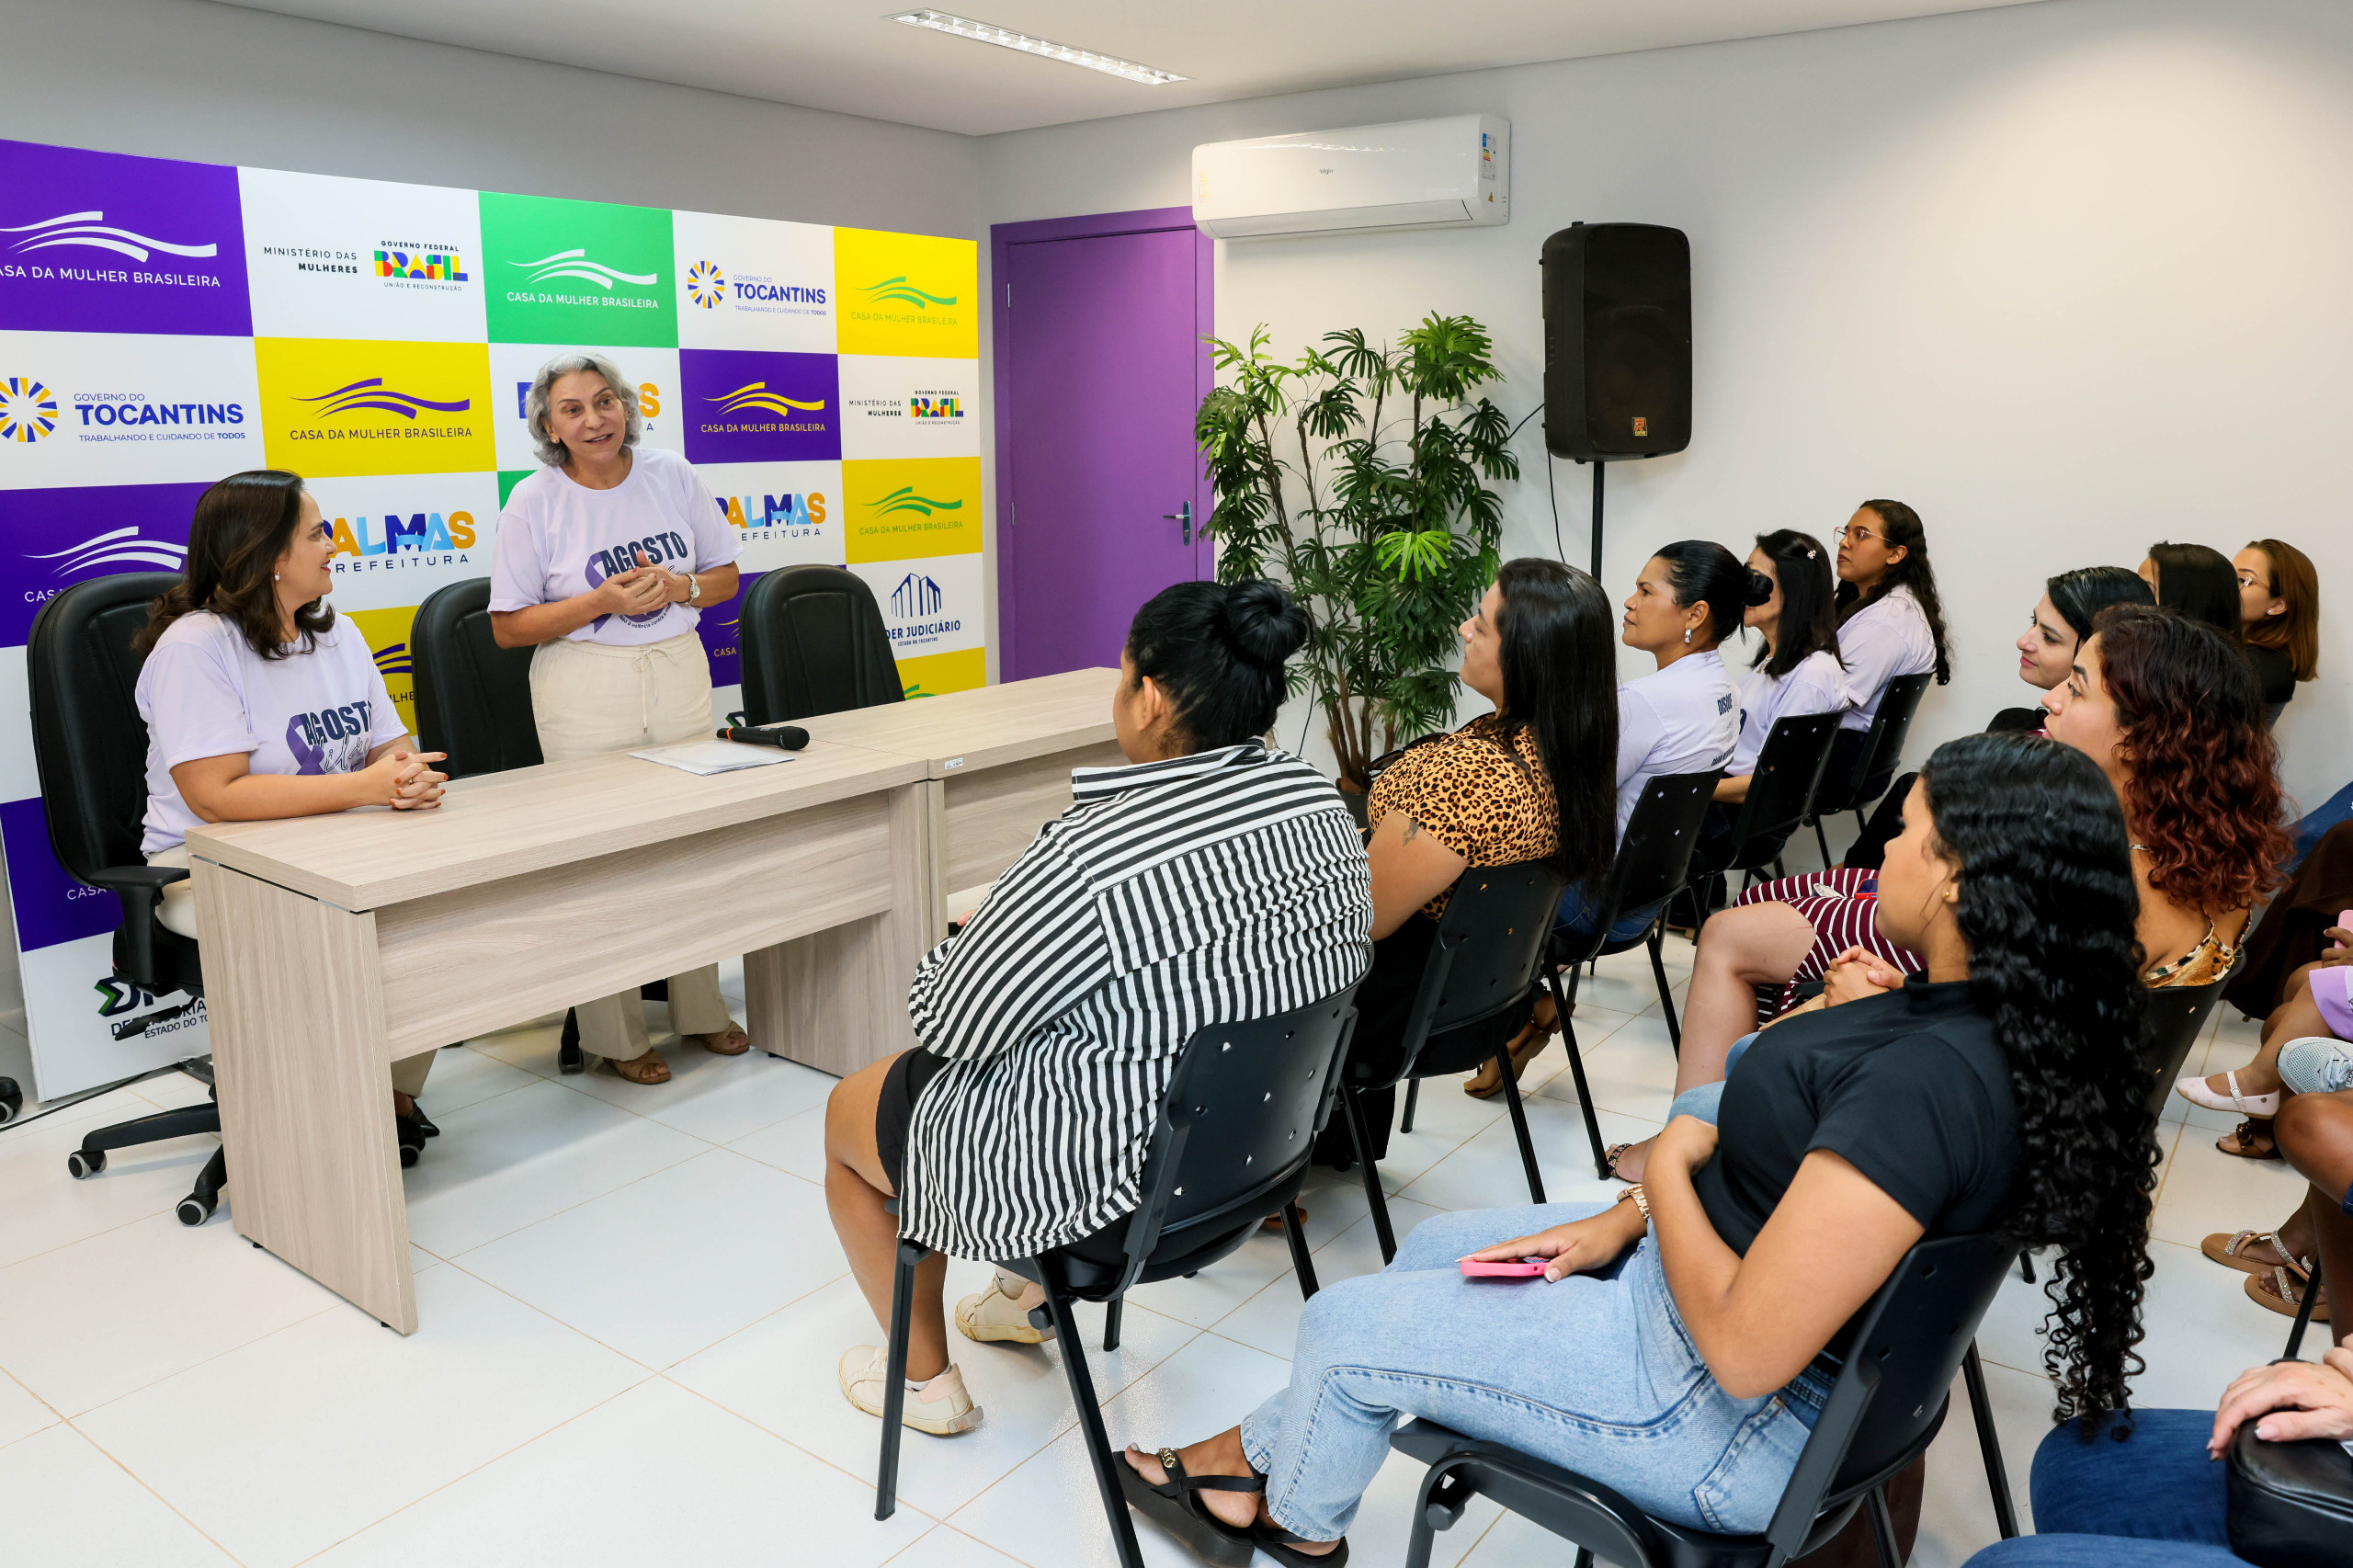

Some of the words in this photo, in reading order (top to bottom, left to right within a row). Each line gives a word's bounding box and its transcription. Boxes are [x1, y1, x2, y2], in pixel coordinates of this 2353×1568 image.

[264, 246, 331, 258] MINISTÉRIO
[336, 252, 357, 260] DAS
[381, 241, 421, 249] GOVERNO
[425, 243, 460, 252] FEDERAL
[298, 263, 358, 273] MULHERES
[374, 250, 468, 281] BRASIL
[0, 265, 26, 278] SA
[31, 267, 54, 278] DA
[60, 268, 128, 282] MULHER
[133, 272, 221, 287] BRASILEIRA
[733, 274, 762, 282] GOVERNO
[412, 283, 462, 291] RECONSTRUÇÃO
[733, 283, 825, 304] TOCANTINS
[506, 291, 536, 302] CASA
[539, 293, 553, 303] DA
[556, 294, 598, 305] MULHER
[602, 296, 658, 309] BRASILEIRA
[851, 312, 871, 321] CASA
[873, 312, 882, 321] DA
[885, 314, 915, 323] MULHER
[918, 316, 958, 325] BRASILEIRA
[75, 403, 244, 426] TOCANTINS
[911, 398, 963, 417] BRASIL
[290, 430, 324, 440] CASA
[328, 429, 345, 439] DA
[349, 428, 401, 438] MULHER
[404, 427, 472, 438] BRASILEIRA
[700, 424, 724, 432] CASA
[727, 424, 739, 432] DA
[741, 424, 777, 432] MULHER
[779, 424, 825, 432] BRASILEIRA
[79, 434, 147, 442] TRABALHANDO
[742, 528, 821, 540] EFEITURA
[859, 527, 879, 535] CASA
[892, 524, 922, 532] MULHER
[924, 521, 962, 530] BRASILEIRA
[599, 531, 688, 579] AGOSTO
[335, 554, 469, 573] REFEITURA
[24, 588, 63, 602] CAS
[885, 628, 904, 640] DER
[906, 619, 961, 637] JUDICIÁRIO
[713, 647, 736, 657] CASA
[144, 1022, 180, 1039] ESTADO
[183, 1017, 197, 1028] DO
